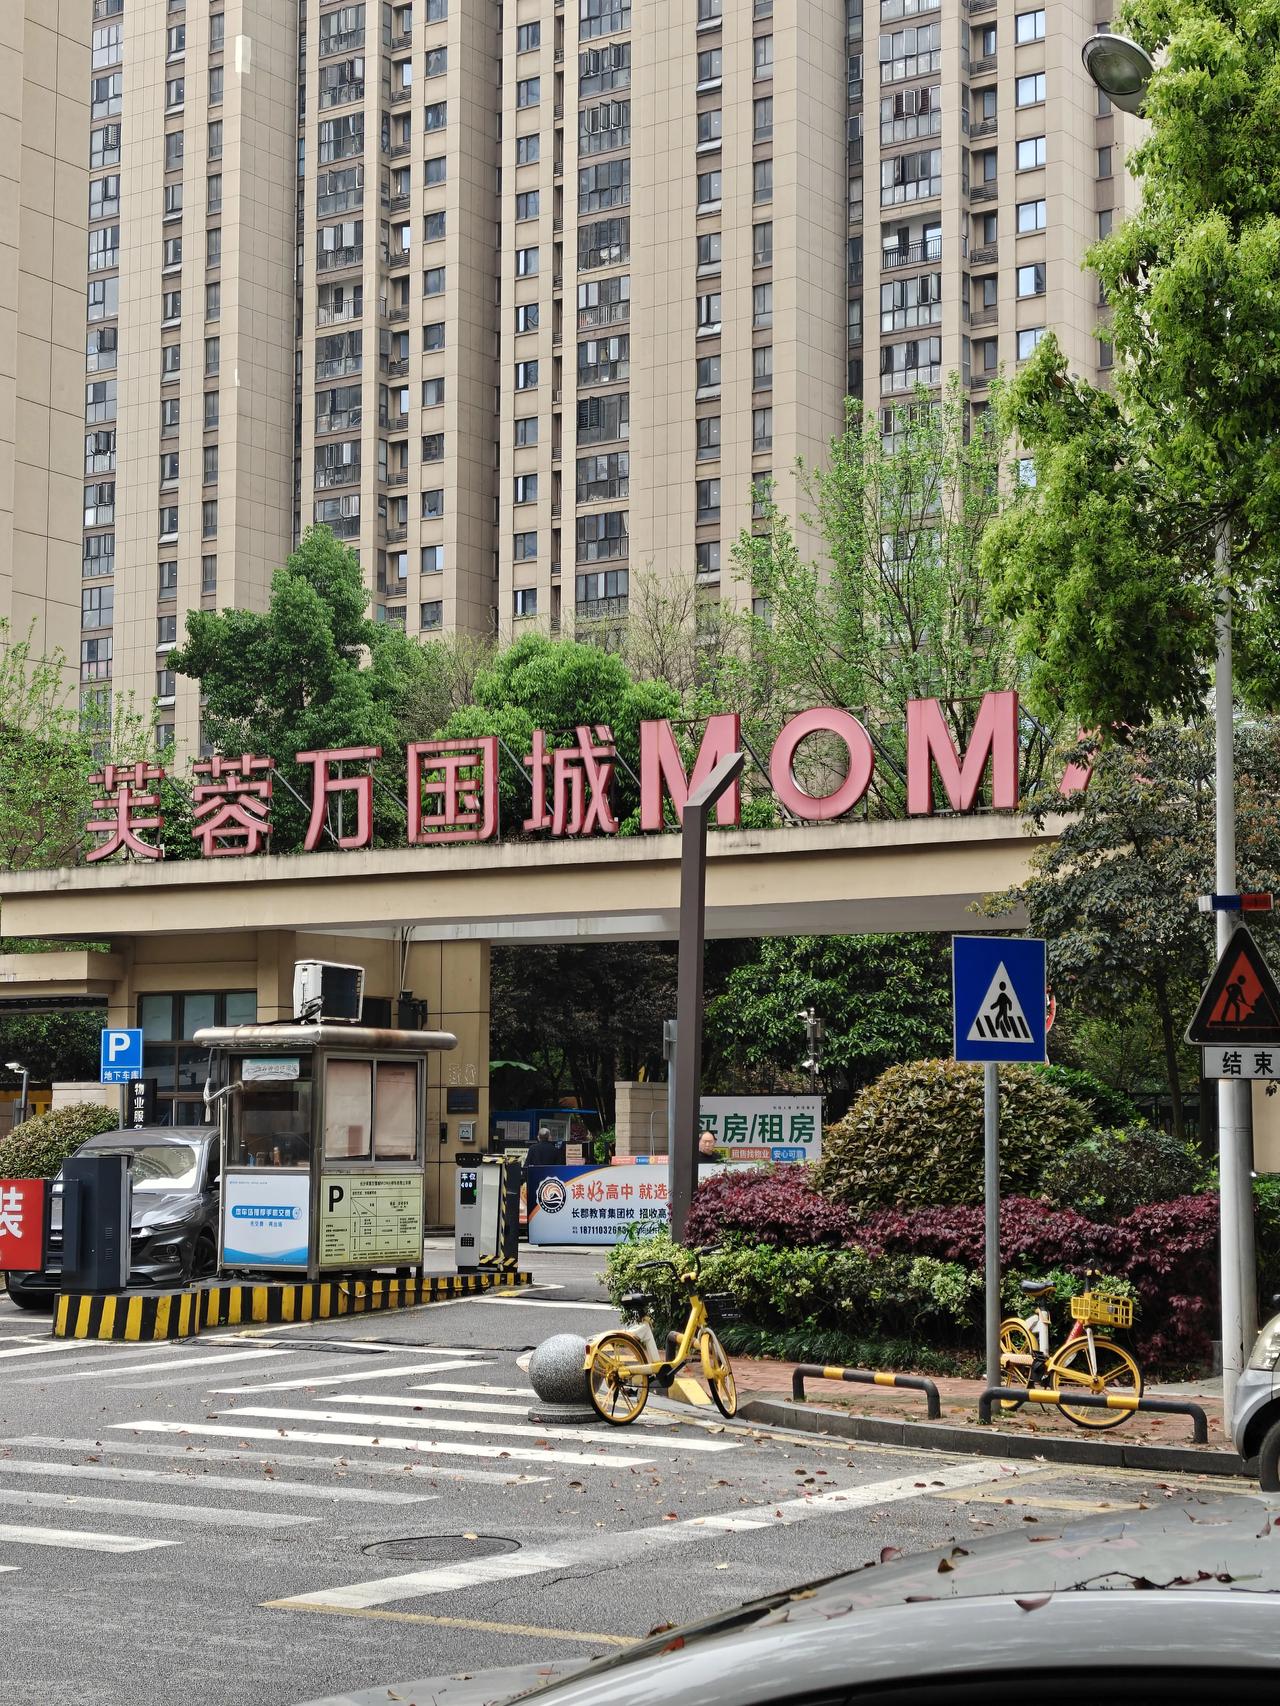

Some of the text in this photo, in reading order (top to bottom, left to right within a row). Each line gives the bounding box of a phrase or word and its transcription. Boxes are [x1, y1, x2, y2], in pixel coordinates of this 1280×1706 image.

[86, 725, 619, 862] 芙蓉万国城
[108, 1032, 131, 1062] P
[1222, 1051, 1274, 1075] 结束
[104, 1070, 140, 1081] 地下车库
[329, 1185, 344, 1212] P
[571, 1180, 634, 1202] 读好高中
[639, 1184, 668, 1200] 就选
[572, 1207, 635, 1219] 长郡教育集团校
